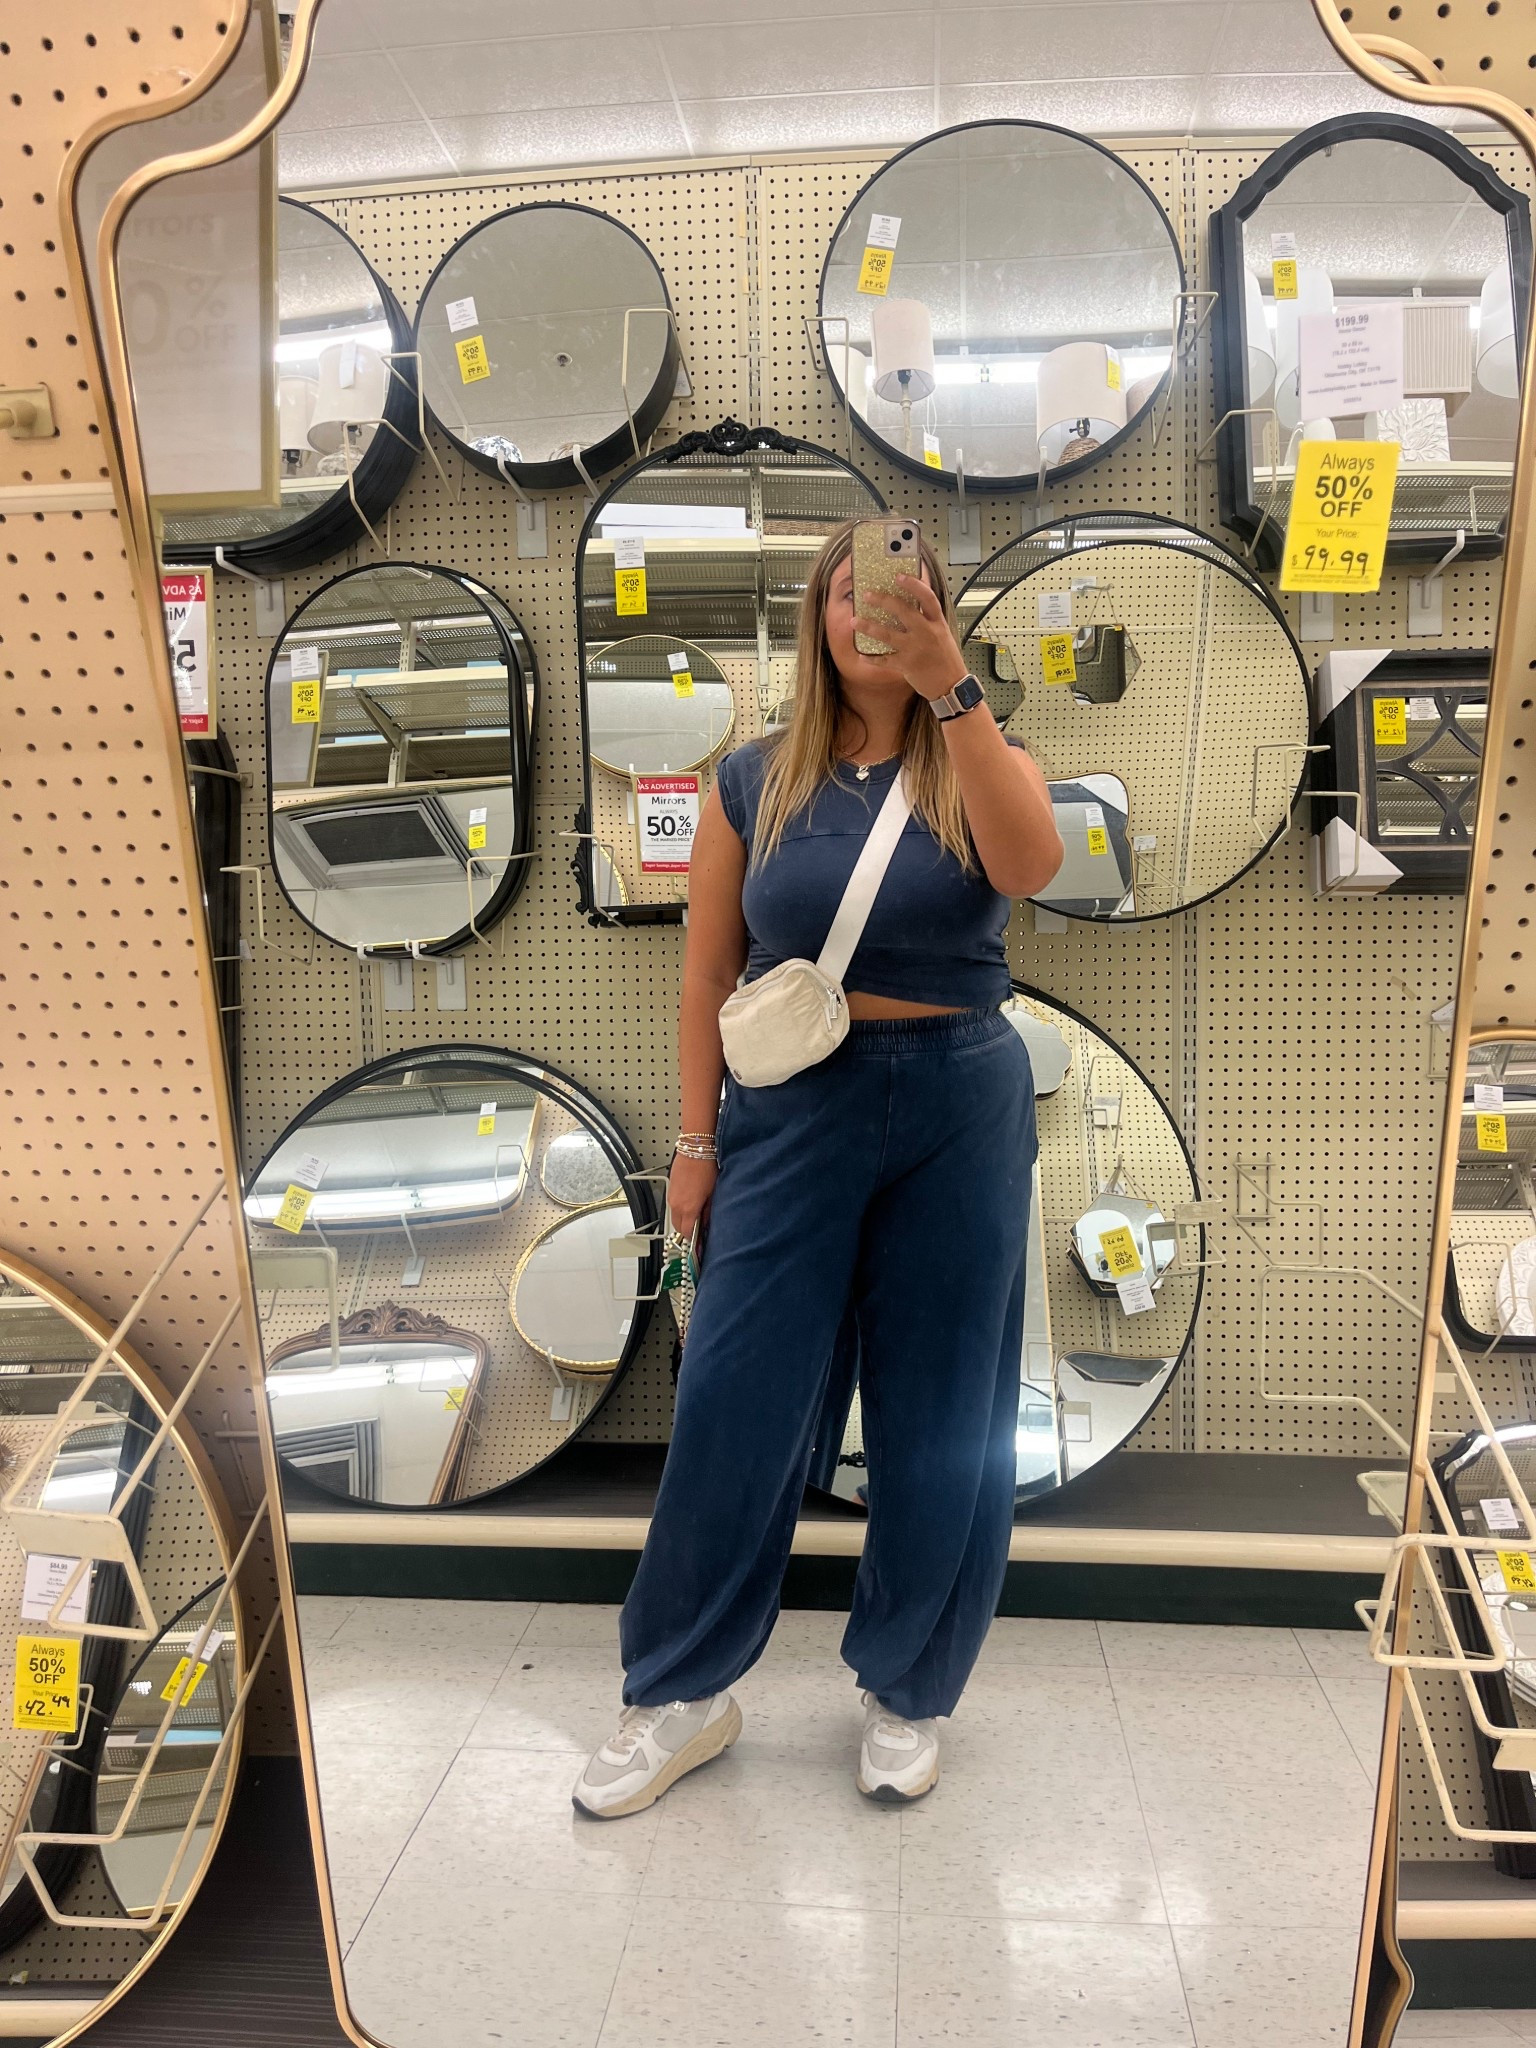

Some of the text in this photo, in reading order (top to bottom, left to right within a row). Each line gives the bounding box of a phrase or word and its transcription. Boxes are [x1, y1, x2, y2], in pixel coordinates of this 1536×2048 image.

[1336, 314, 1369, 327] $199.99
[1320, 453, 1375, 474] Always
[1315, 475, 1373, 500] 50%
[1321, 501, 1363, 518] OFF
[1317, 529, 1334, 538] Your
[651, 796, 687, 805] Mirrors
[31, 1644, 65, 1658] Always
[29, 1658, 66, 1674] 50%
[34, 1673, 60, 1684] OFF
